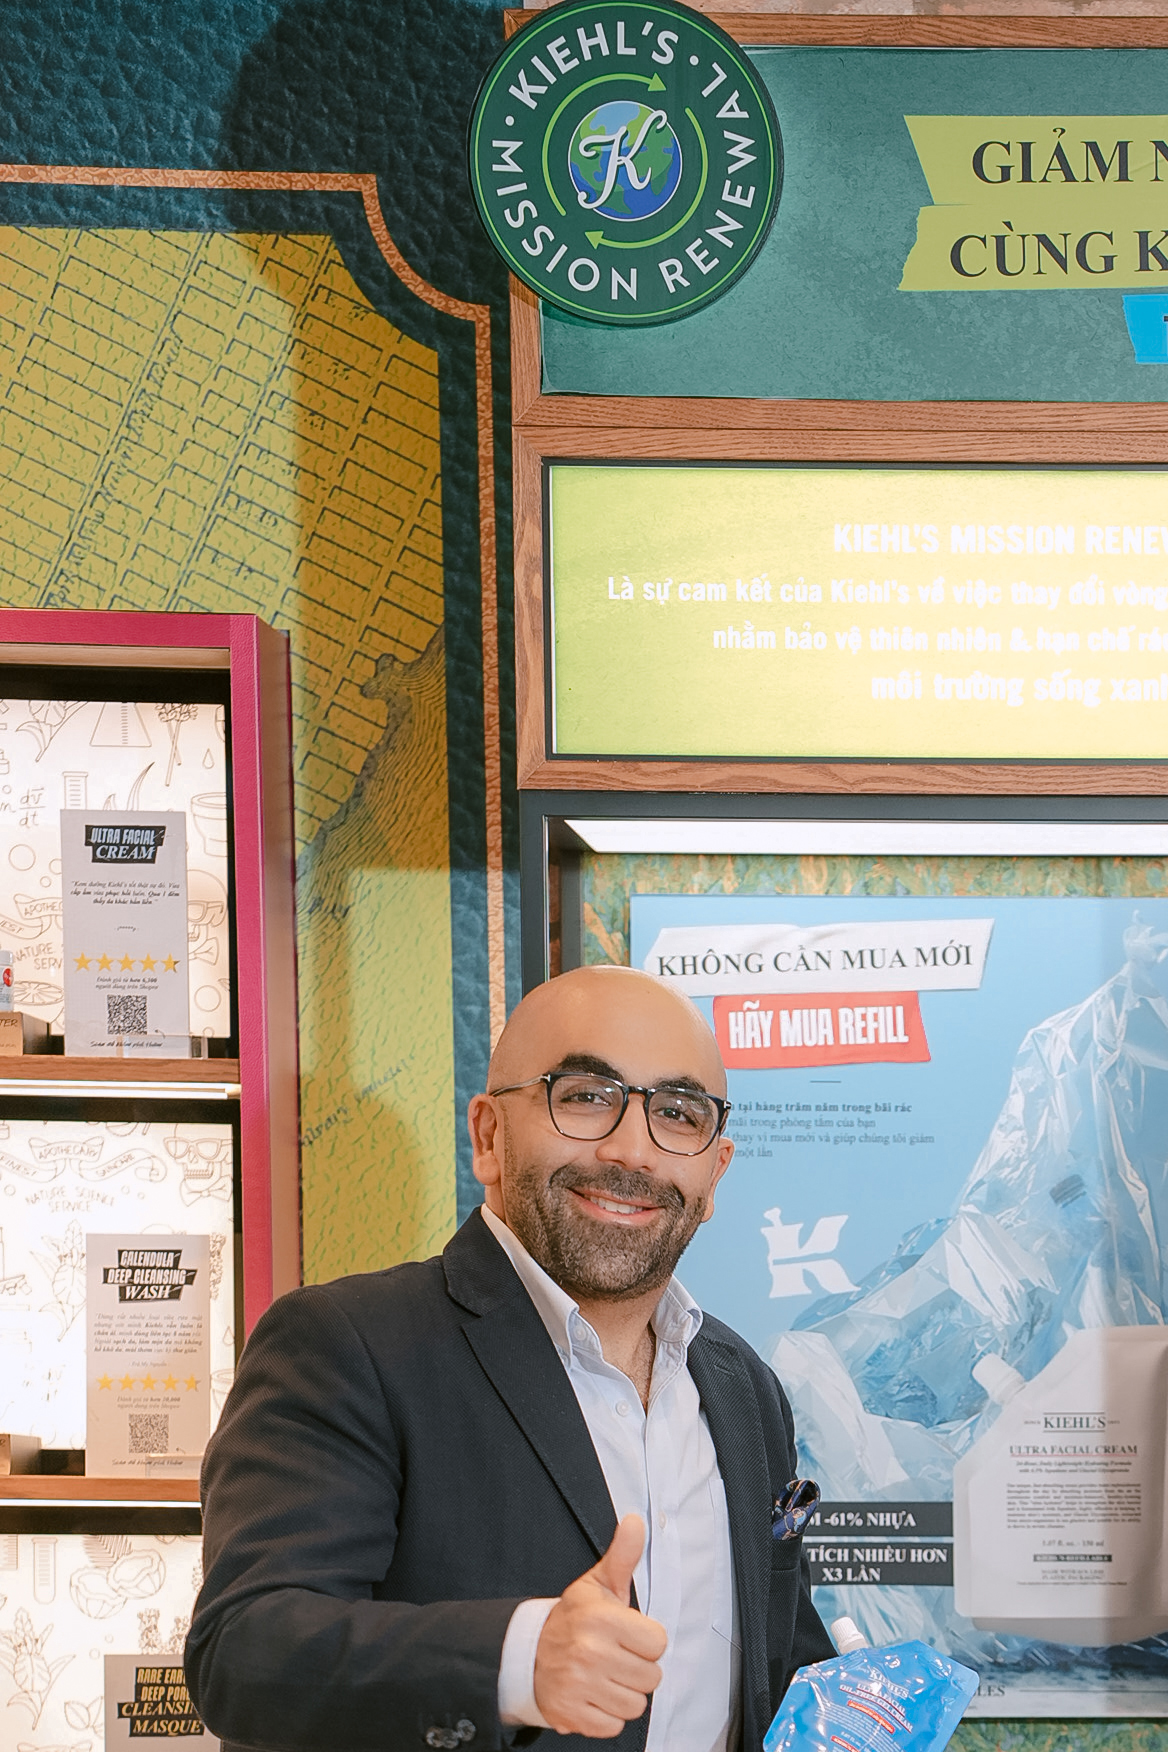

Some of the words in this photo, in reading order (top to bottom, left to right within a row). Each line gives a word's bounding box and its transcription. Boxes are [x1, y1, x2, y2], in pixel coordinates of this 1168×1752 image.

[508, 20, 680, 110] KIEHL'S
[971, 127, 1134, 184] GIẢM
[491, 139, 638, 301] MISSION
[657, 61, 758, 294] RENEWAL
[949, 220, 1118, 277] CÙNG
[833, 524, 940, 554] KIEHL'S
[951, 525, 1075, 555] MISSION
[608, 575, 635, 600] Là
[642, 577, 673, 606] sự
[679, 582, 727, 601] cam
[736, 573, 772, 603] kết
[780, 576, 822, 604] của
[831, 580, 910, 604] Kiehl's
[918, 577, 945, 604] về
[953, 581, 1002, 608] việc
[1012, 582, 1062, 611] thay
[1069, 573, 1106, 605] đổi
[713, 620, 777, 650] nhằm
[785, 621, 828, 650] bảo
[836, 627, 863, 655] vệ
[870, 626, 929, 651] thiên
[937, 627, 1002, 652] nhiên
[1010, 630, 1032, 653] &
[1038, 628, 1080, 656] hạn
[1087, 625, 1136, 652] chế
[871, 671, 923, 700] môi
[934, 671, 1024, 707] trường
[1033, 668, 1101, 707] sống
[90, 827, 120, 845] ULTRA
[122, 828, 156, 846] FACIAL
[95, 846, 156, 860] CREAM
[657, 948, 765, 977] KHÔNG
[773, 944, 833, 973] CẦN
[841, 948, 908, 970] MUA
[914, 940, 973, 968] MỚI
[728, 1000, 774, 1049] HÃY
[779, 1008, 835, 1047] MUA
[838, 1004, 910, 1045] REFILL
[755, 1101, 783, 1114] hàng
[842, 1103, 872, 1114] trong
[750, 1118, 778, 1129] trong
[120, 1251, 176, 1267] CALENDULA
[107, 1270, 131, 1284] DEEP
[133, 1269, 187, 1284] CLEANSING
[125, 1285, 171, 1299] WASH
[1043, 1416, 1107, 1429] KIEHL'S
[1009, 1445, 1048, 1455] ULTRA
[1050, 1445, 1091, 1455] FACIAL
[1094, 1444, 1138, 1454] CREAM
[823, 1512, 863, 1527] -61%
[867, 1511, 917, 1530] NHỰA
[807, 1545, 850, 1563] TÍCH
[852, 1545, 907, 1563] NHIỀU
[910, 1547, 948, 1563] HƠN
[822, 1567, 843, 1582] X3
[846, 1565, 881, 1582] LẦN
[137, 1668, 164, 1684] RARE
[164, 1669, 186, 1684] EAR
[141, 1686, 165, 1701] DEEP
[132, 1720, 202, 1736] MASQUE
